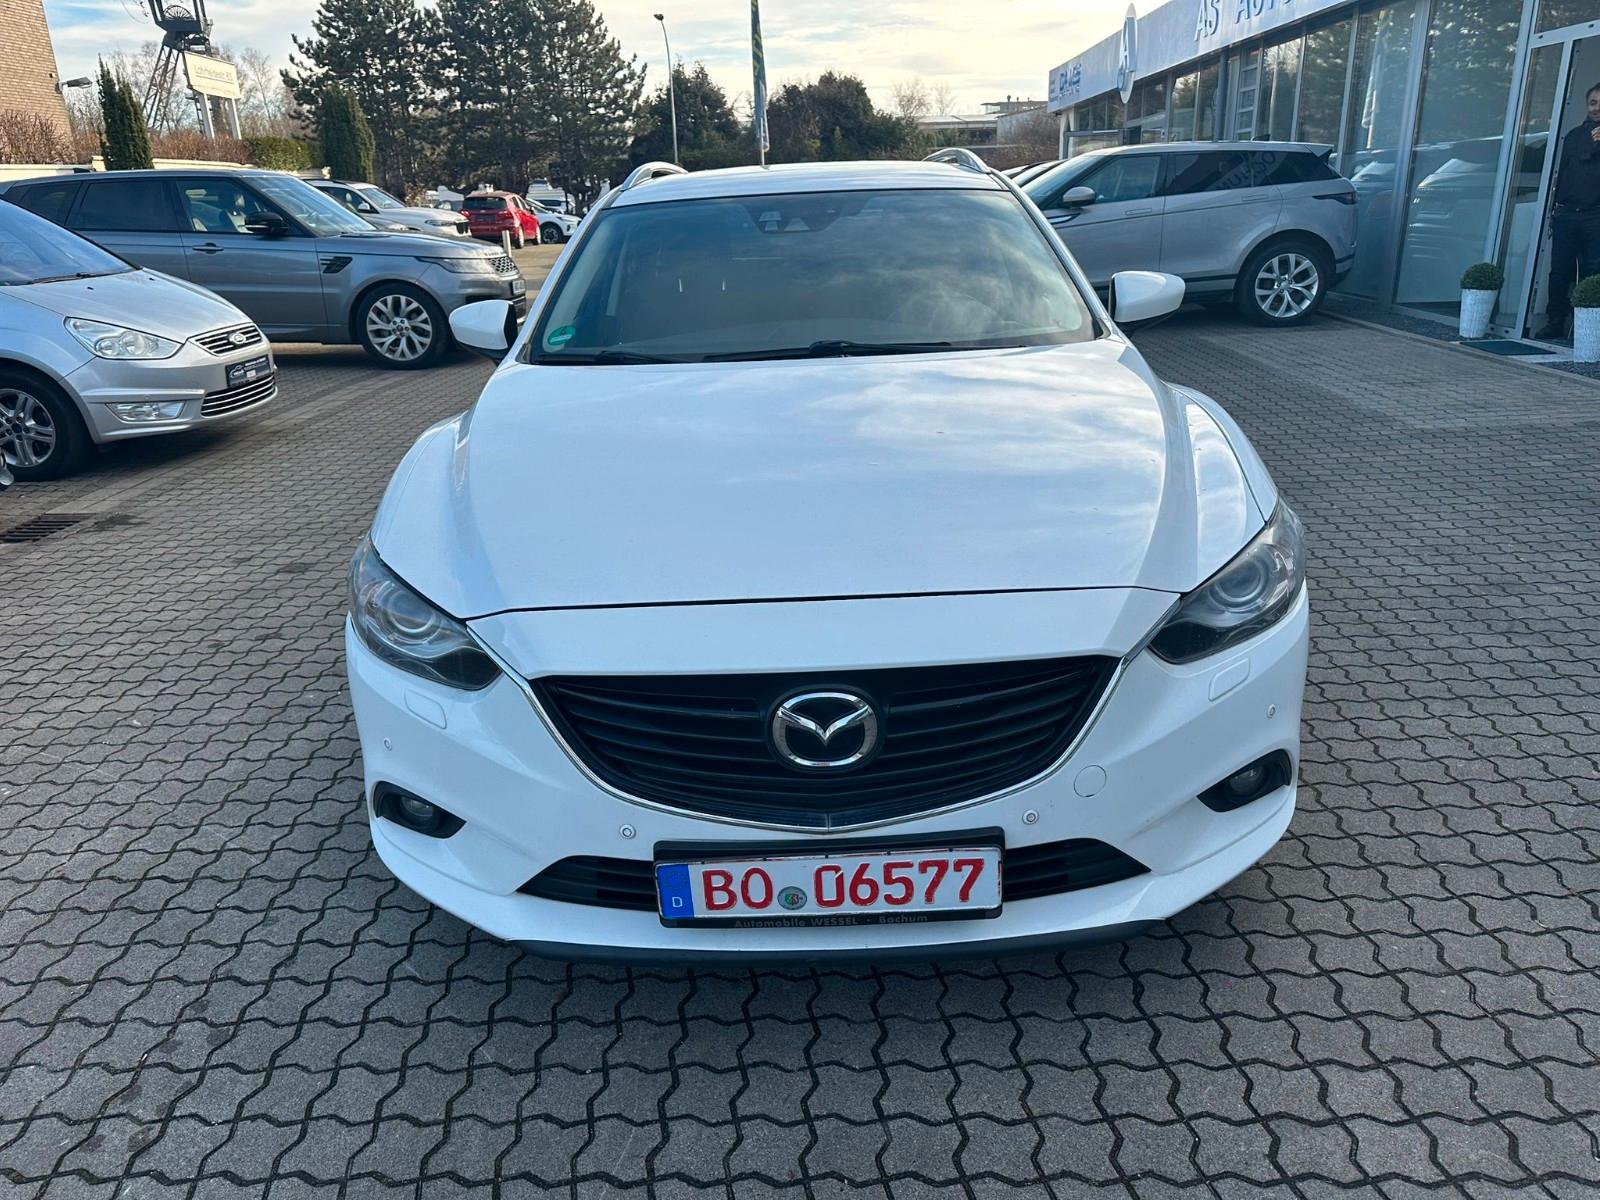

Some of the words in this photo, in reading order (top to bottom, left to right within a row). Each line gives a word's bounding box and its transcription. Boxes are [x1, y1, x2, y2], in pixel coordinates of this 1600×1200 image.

[702, 867, 773, 911] BO
[812, 857, 985, 909] 06577
[671, 896, 683, 908] D
[734, 918, 806, 929] Automobile
[810, 917, 858, 927] WESSEL
[879, 914, 928, 924] Bochum
